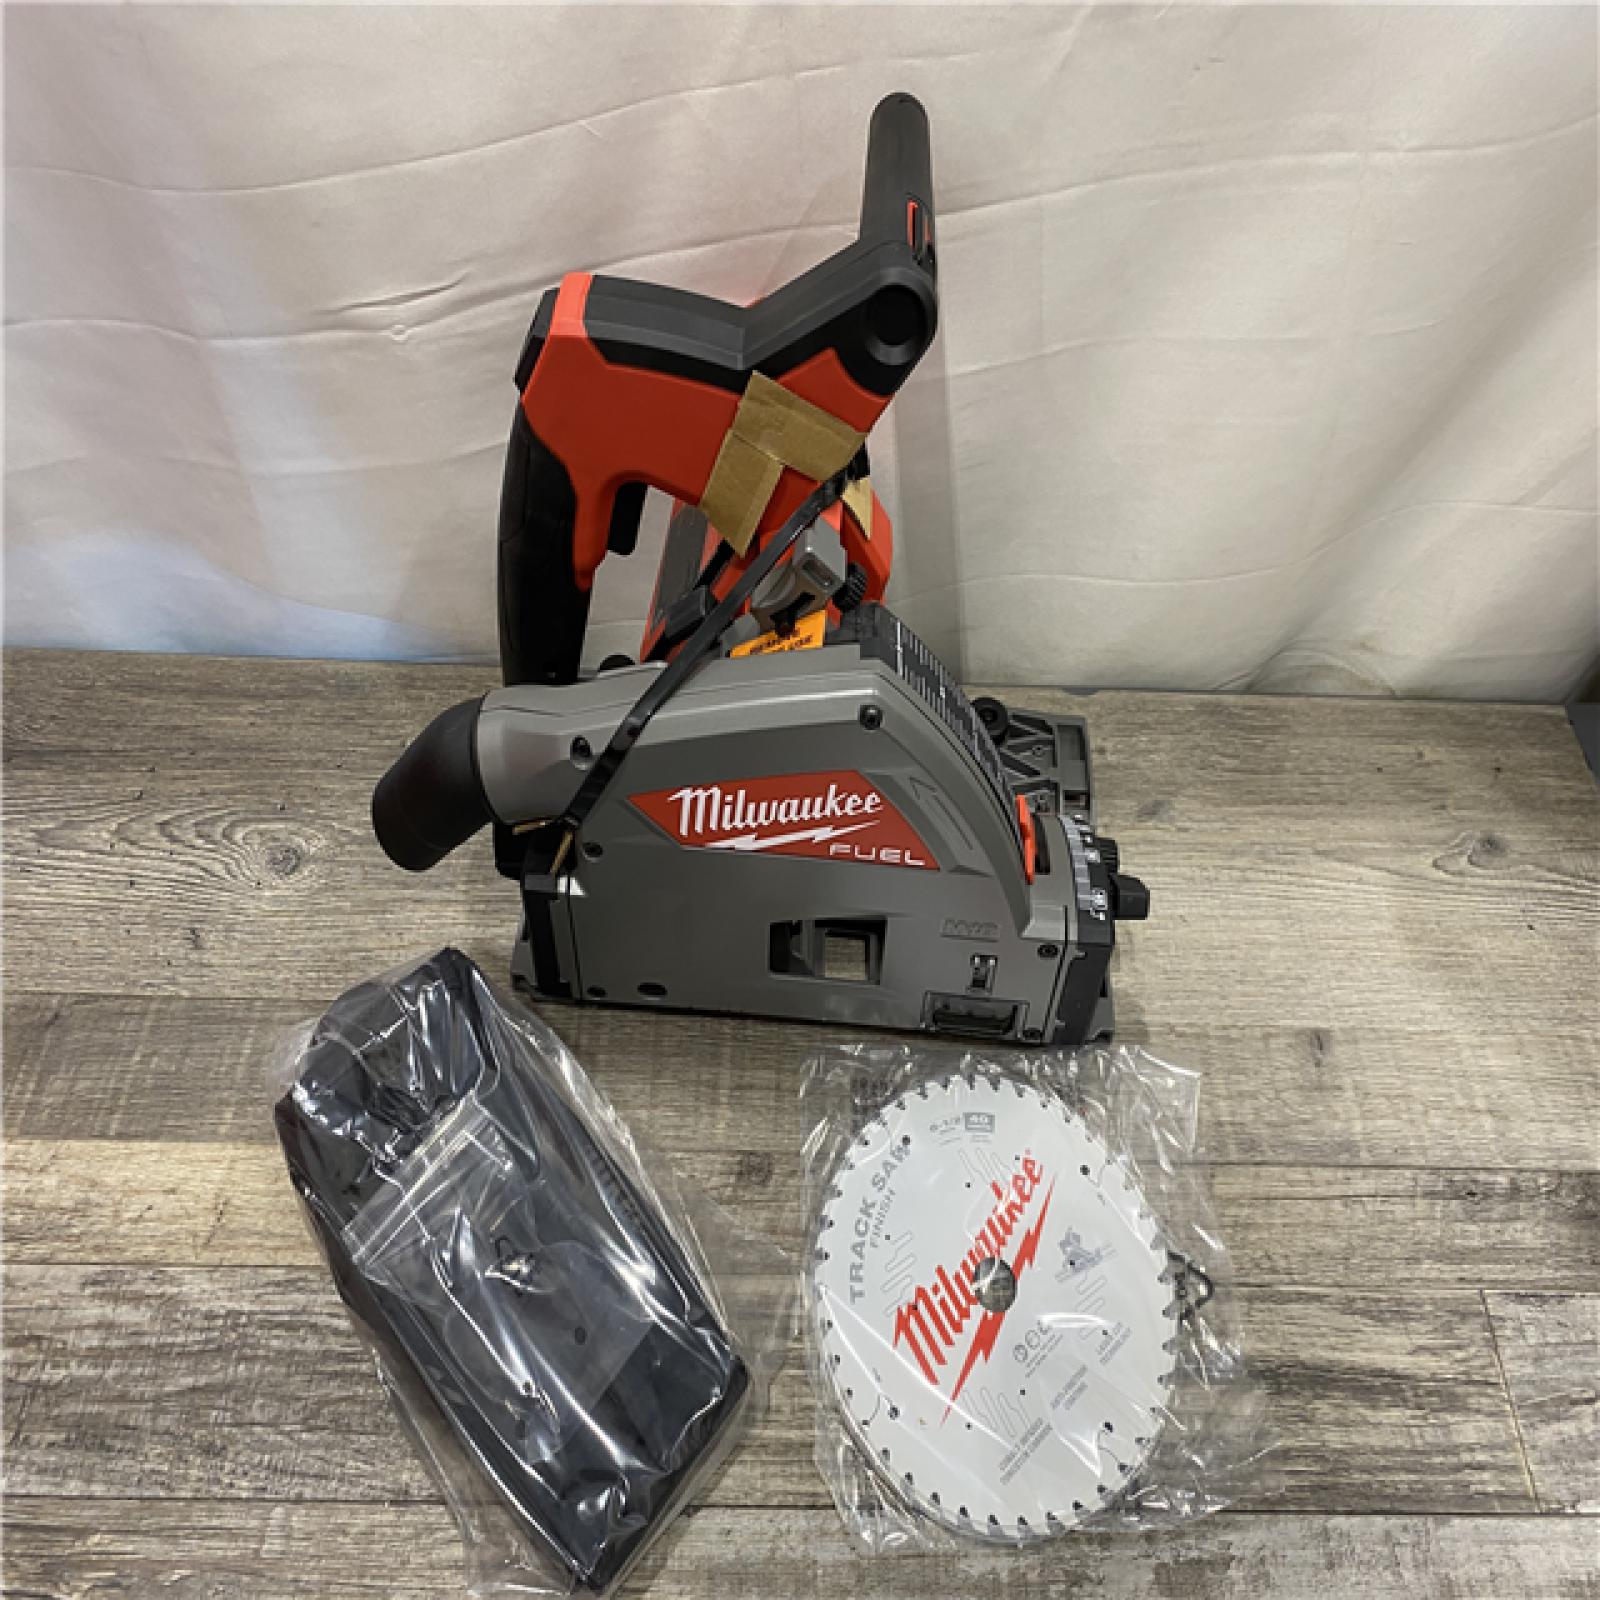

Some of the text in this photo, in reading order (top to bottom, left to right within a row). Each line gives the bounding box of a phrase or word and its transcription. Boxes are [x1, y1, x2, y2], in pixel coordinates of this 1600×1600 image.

[668, 784, 882, 835] Milwaukee
[829, 844, 926, 866] FUEL
[870, 1187, 896, 1248] FINISH
[850, 1197, 876, 1304] TRACK
